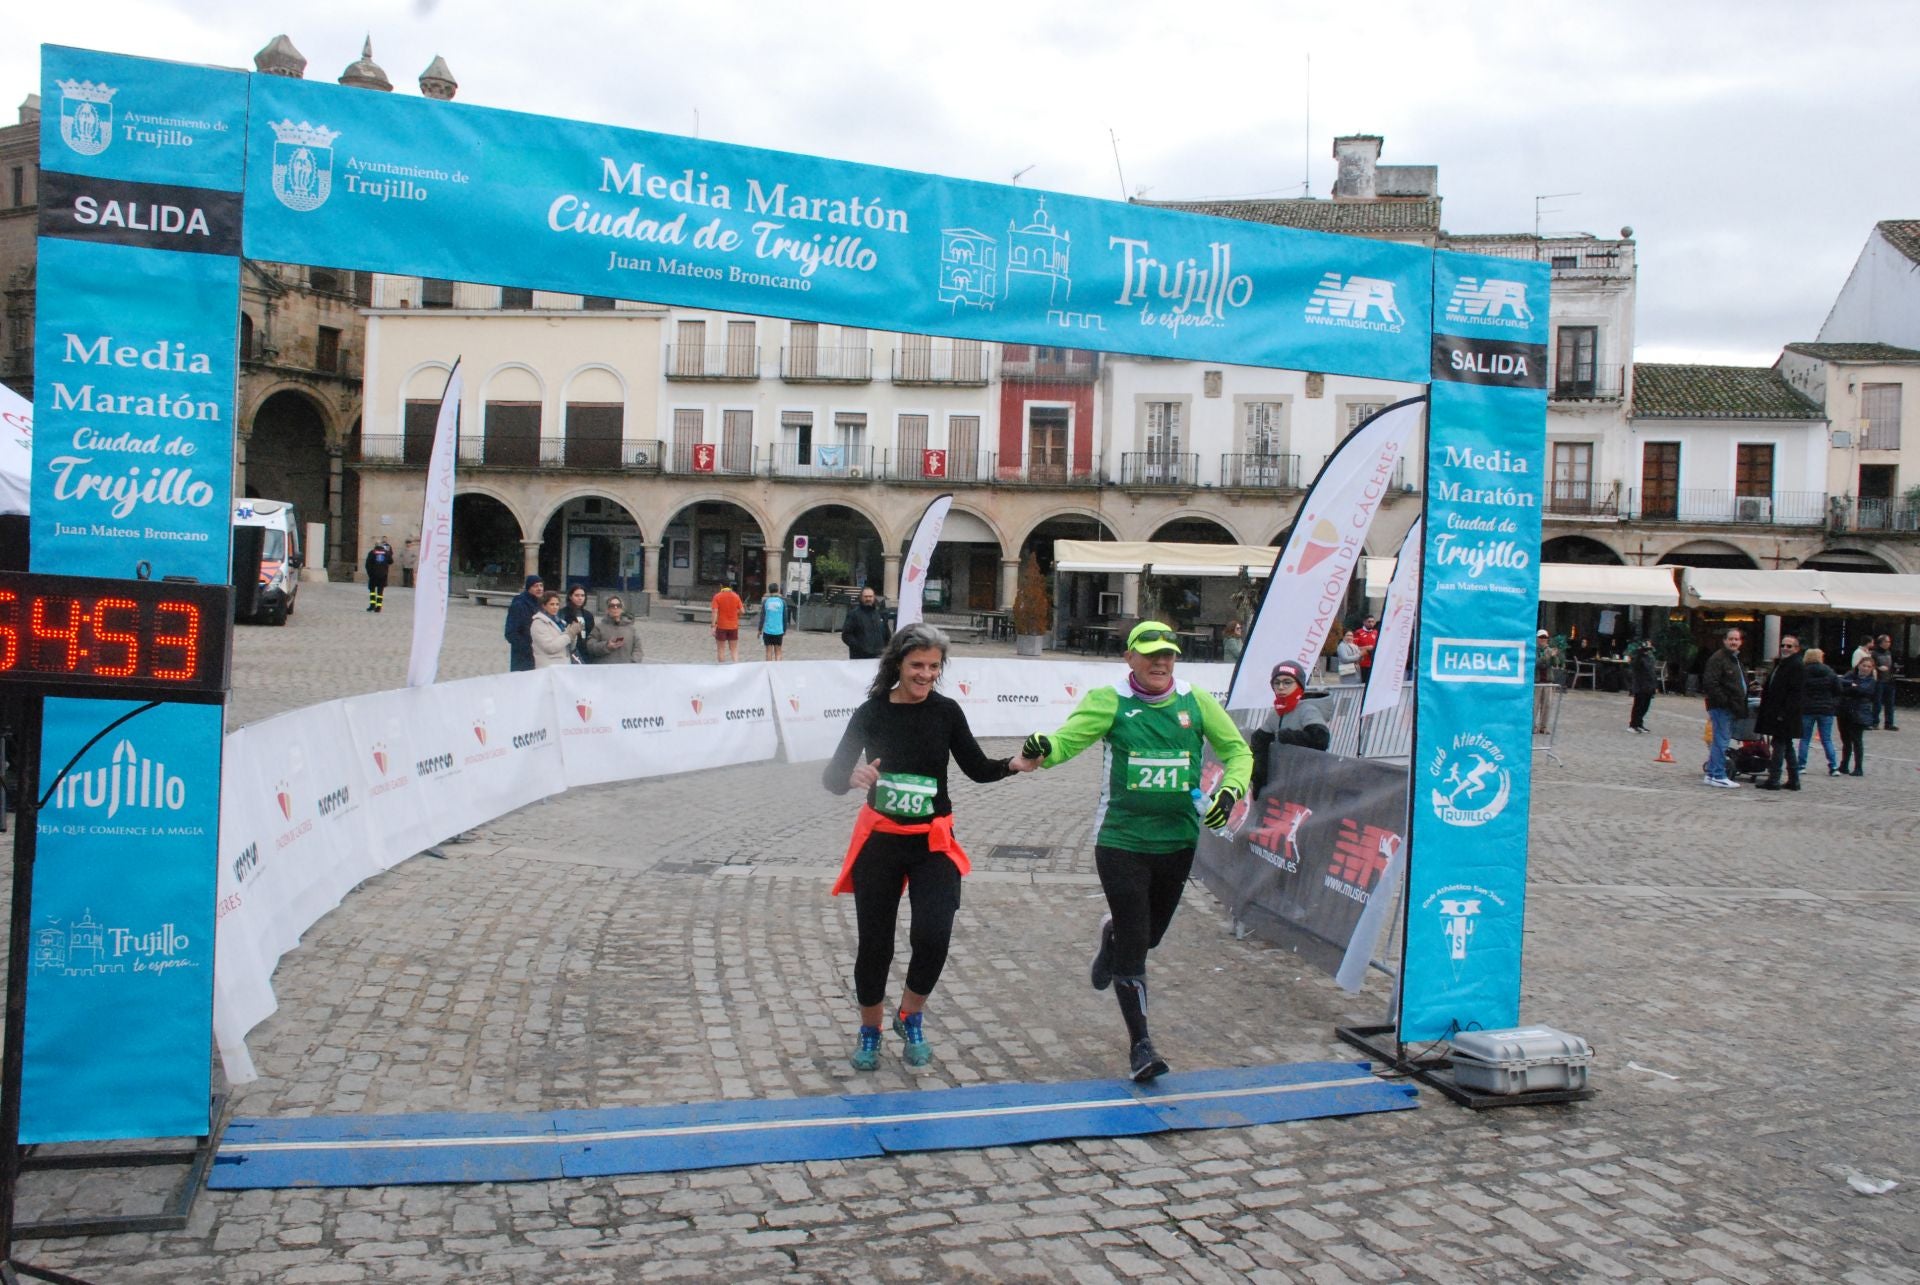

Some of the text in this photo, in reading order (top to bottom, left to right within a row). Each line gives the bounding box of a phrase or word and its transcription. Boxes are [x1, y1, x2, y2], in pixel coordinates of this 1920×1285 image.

[124, 111, 229, 132] Ayuntamiento de
[123, 125, 193, 148] Trujillo
[347, 157, 470, 184] Ayuntamiento de
[344, 174, 428, 202] Trujillo
[598, 156, 910, 234] Media Maratón
[74, 196, 210, 236] SALIDA
[547, 194, 878, 278] Ciudad de Trujillo
[608, 252, 812, 291] Juan Mateos Broncano
[1109, 235, 1254, 320] Trujillo
[1140, 301, 1156, 326] te
[1304, 313, 1402, 334] www.musicrun.es
[1445, 312, 1530, 331] www.musicrun.es
[62, 333, 213, 375] Media
[1451, 350, 1529, 377] SALIDA
[51, 382, 222, 422] Maratón
[72, 426, 198, 457] Ciudad de
[1443, 445, 1529, 474] Media
[48, 455, 215, 520] Trujillo
[1438, 479, 1535, 508] Maratón
[54, 522, 209, 542] Juan Mateos Broncano
[1447, 512, 1518, 533] Ciudad de
[1339, 535, 1359, 561] DE
[1434, 532, 1530, 579] Trujillo
[1435, 580, 1456, 592] Juan
[1457, 581, 1488, 592] Mateos
[1444, 650, 1511, 673] HABLA
[1452, 731, 1505, 761] Atletismo
[1138, 767, 1178, 789] 241
[884, 789, 925, 815] 249
[63, 824, 87, 837] QUE
[89, 825, 148, 836] COMIENCE
[151, 826, 165, 836] LA
[167, 826, 205, 837] MAGIA
[107, 923, 190, 957] Trujillo
[1445, 919, 1474, 936] A J
[1455, 936, 1463, 951] S
[133, 957, 148, 973] te
